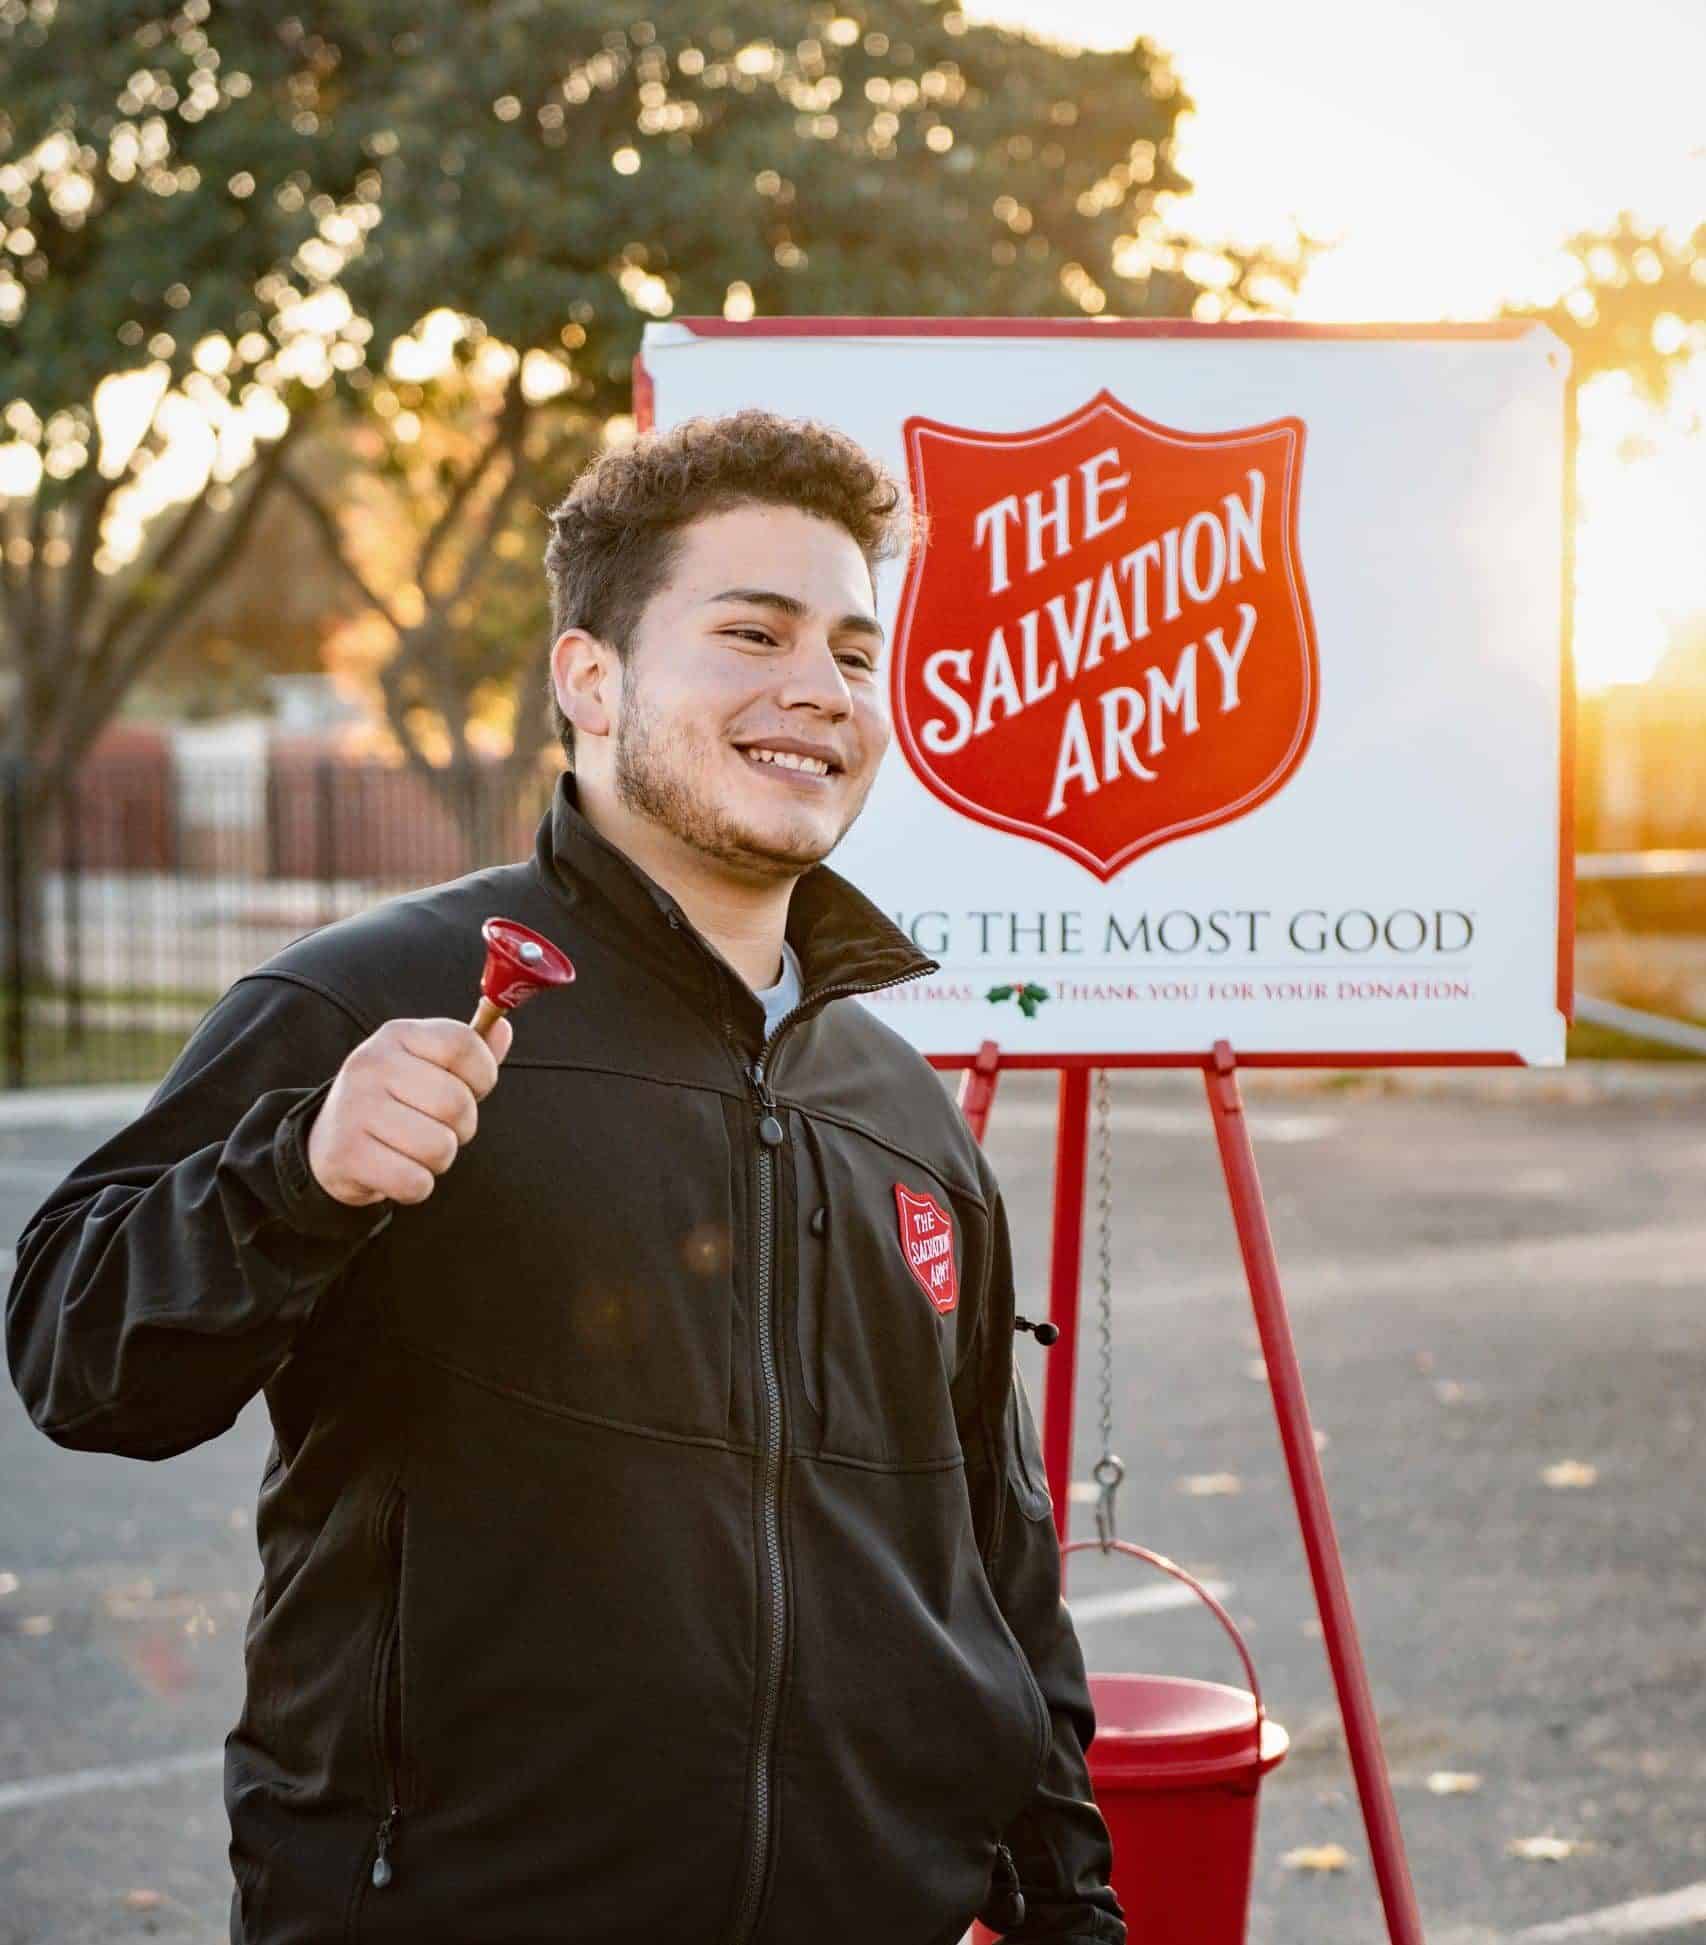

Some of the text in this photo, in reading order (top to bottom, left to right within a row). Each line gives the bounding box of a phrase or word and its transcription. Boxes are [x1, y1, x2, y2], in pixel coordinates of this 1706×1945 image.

[973, 447, 1131, 597] THE
[921, 469, 1266, 755] SALVATION
[1045, 603, 1257, 819] ARMY
[967, 910, 1083, 953] THE
[1104, 909, 1271, 954] MOST
[1288, 909, 1474, 953] GOOD
[1056, 980, 1138, 1001] THANK
[1149, 984, 1198, 1001] YOU
[1207, 984, 1254, 1001] FOR
[1263, 984, 1328, 1001] YOUR
[914, 1211, 935, 1234] THE
[931, 1259, 949, 1288] ARMY
